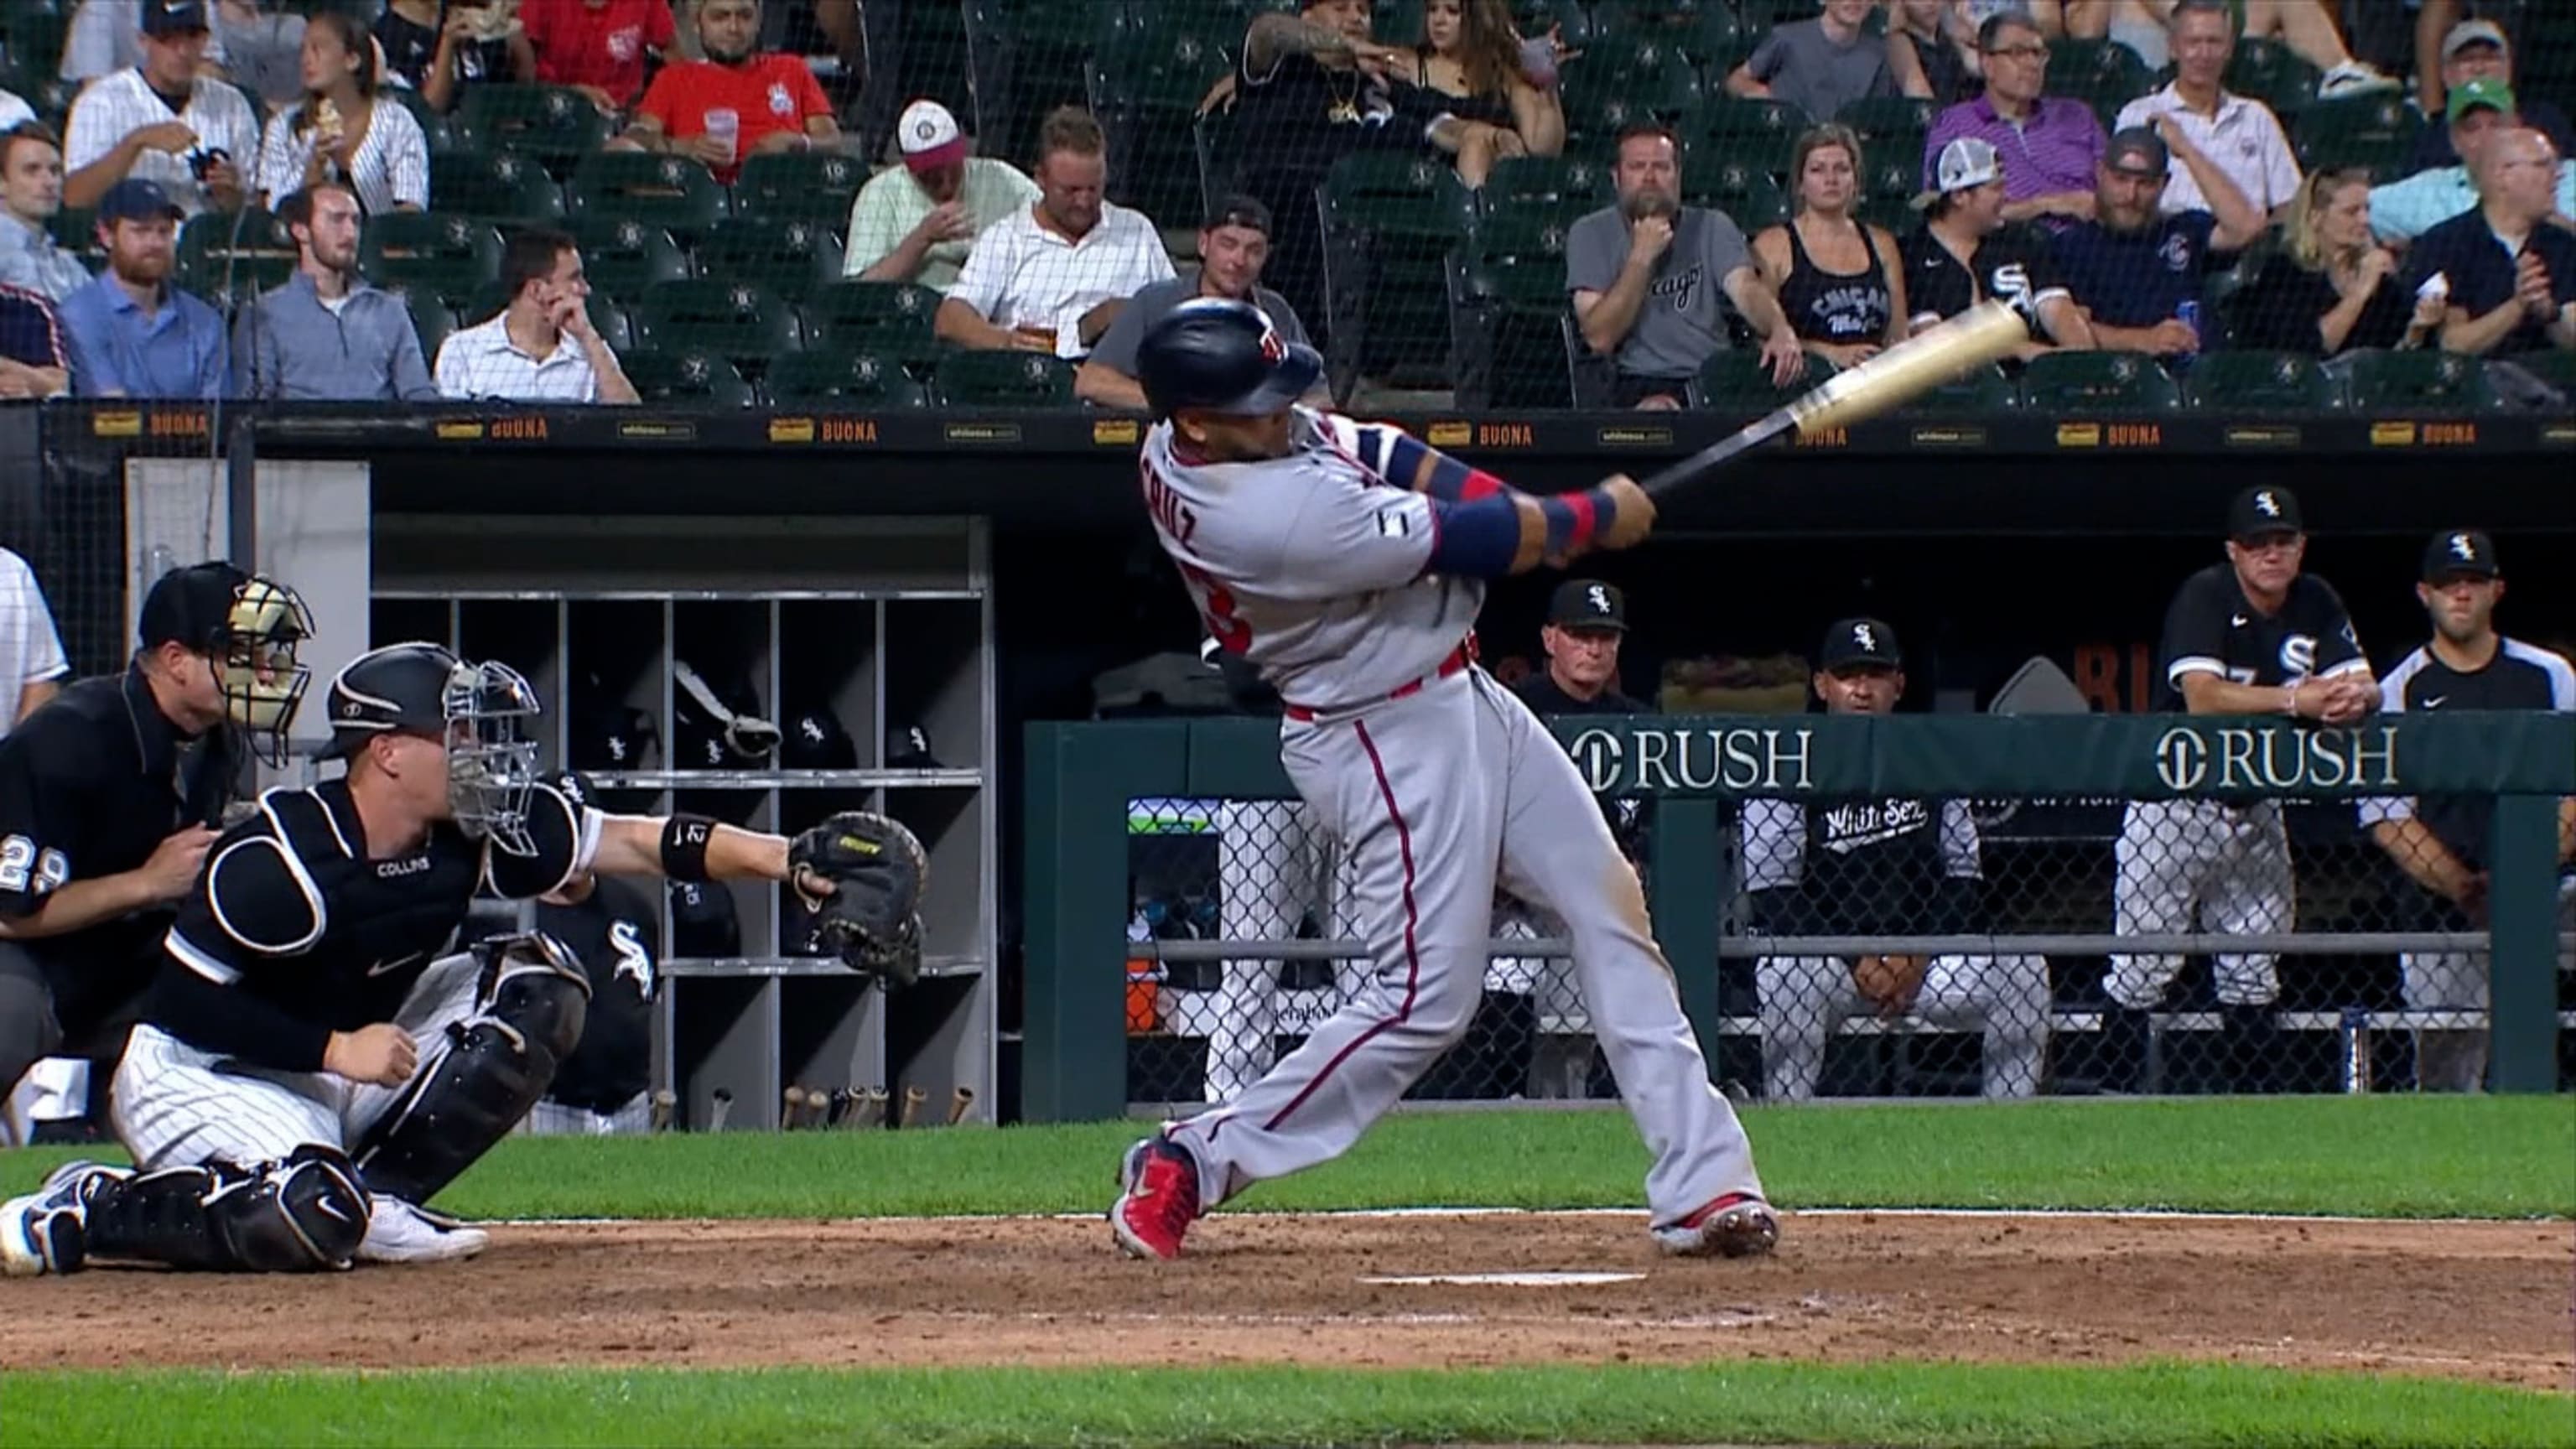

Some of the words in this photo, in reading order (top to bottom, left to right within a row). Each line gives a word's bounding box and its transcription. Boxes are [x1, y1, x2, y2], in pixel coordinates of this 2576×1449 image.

[822, 423, 876, 442] BUONA
[1479, 424, 1532, 446] BUONA
[2108, 425, 2160, 445] BUONA
[2423, 423, 2475, 444] BUONA
[1633, 730, 1813, 789] RUSH
[2218, 727, 2398, 787] RUSH
[377, 855, 431, 878] COLLINS
